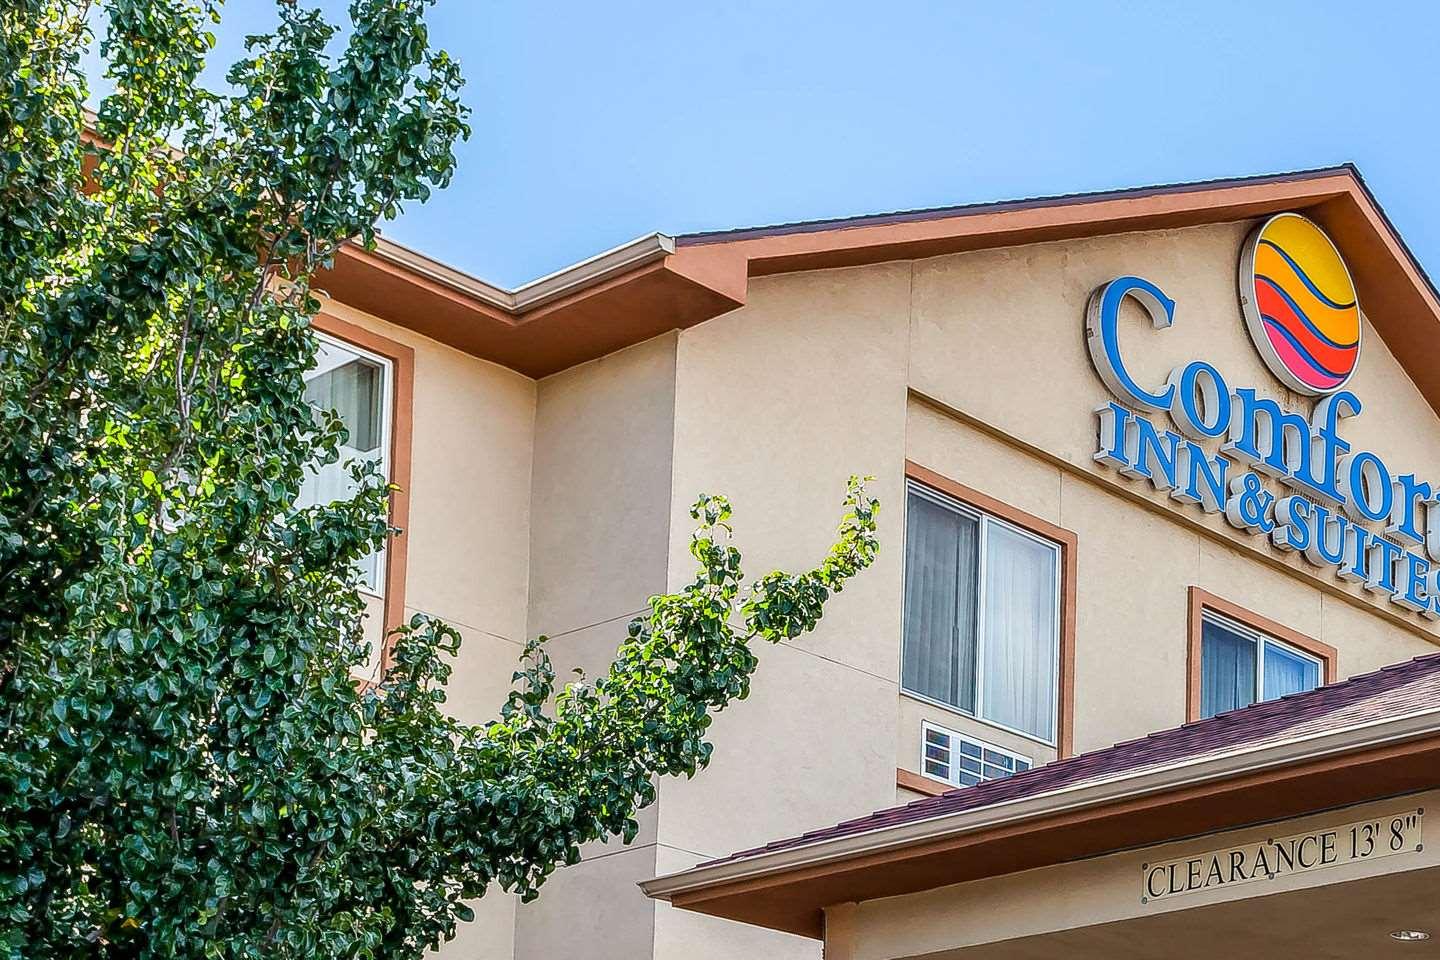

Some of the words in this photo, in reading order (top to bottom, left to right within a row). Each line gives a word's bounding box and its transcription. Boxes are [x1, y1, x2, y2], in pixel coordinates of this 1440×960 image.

[1101, 401, 1231, 513] INN
[1232, 472, 1275, 534] &
[1147, 832, 1337, 898] CLEARANCE
[1350, 823, 1380, 859] 13'
[1389, 815, 1417, 851] 8"
